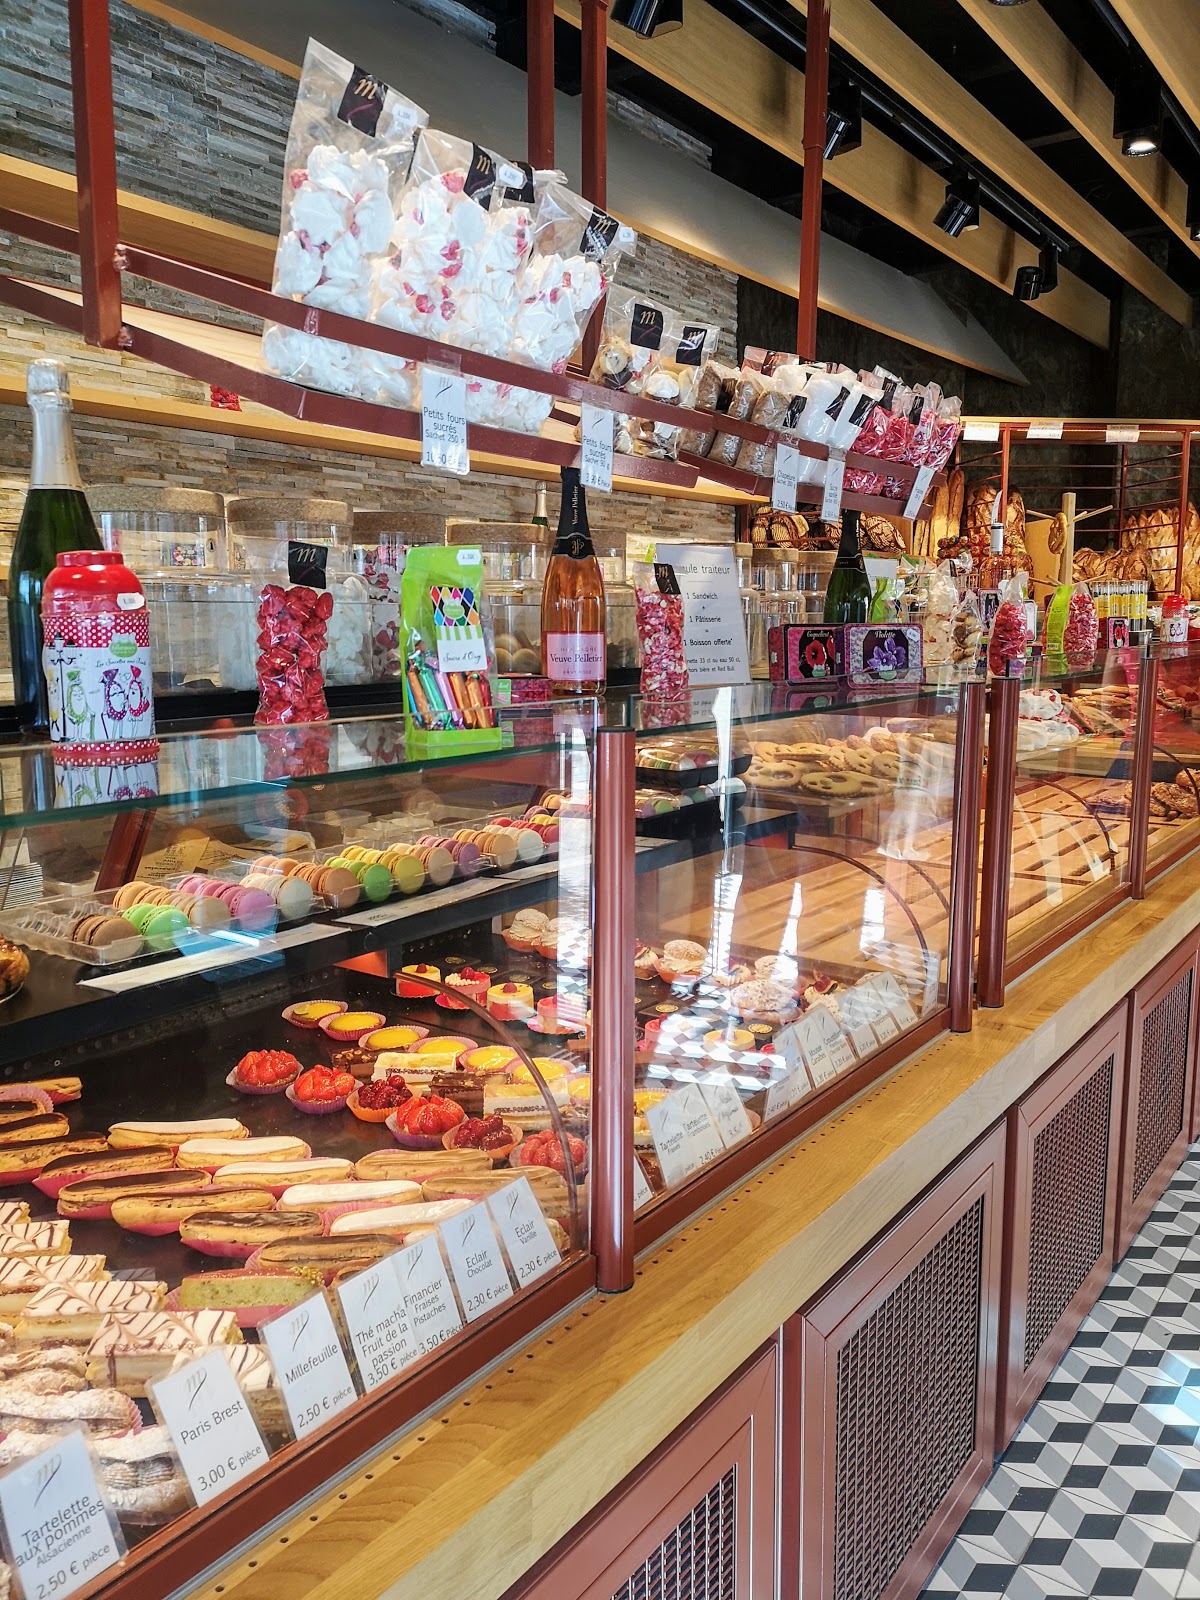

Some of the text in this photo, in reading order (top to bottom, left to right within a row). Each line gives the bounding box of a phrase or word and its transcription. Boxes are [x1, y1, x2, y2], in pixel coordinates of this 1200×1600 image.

[423, 406, 465, 425] Petits fours
[425, 429, 445, 441] Sachet
[447, 434, 458, 443] 250
[433, 421, 457, 434] sucrés
[583, 434, 612, 453] Petits fours
[701, 565, 731, 575] traiteur
[686, 592, 719, 600] 1 Sandwich
[689, 615, 721, 623] 1 Pâtisserie
[683, 639, 687, 647] 1
[550, 653, 603, 663] Veuve Pelletier
[683, 1113, 709, 1132] Tartelette
[659, 1131, 684, 1152] Tartelette
[698, 1150, 712, 1165] 2,40
[711, 1148, 716, 1158] €
[684, 1162, 695, 1174] pièce
[637, 1186, 649, 1199] pièce
[514, 1220, 535, 1239] Eclair
[520, 1230, 538, 1246] Vanille
[465, 1249, 488, 1270] Eclair
[467, 1259, 493, 1279] Chocolat
[518, 1249, 558, 1279] 2,30 € pièce
[403, 1279, 443, 1309] Financier
[414, 1293, 440, 1314] Fraises
[466, 1282, 509, 1313] 2,30 € pièce
[355, 1307, 407, 1345] Thé macha
[413, 1303, 447, 1328] Pistaches
[361, 1323, 408, 1358] Fruit de la
[419, 1333, 440, 1356] 3,50
[439, 1329, 446, 1343] €
[285, 1344, 339, 1385] Millefeuille
[371, 1338, 407, 1370] passion
[367, 1348, 418, 1387] 3,50 € pièce
[297, 1385, 353, 1428] 2,50 € pièce
[180, 1399, 244, 1445] Paris Brest
[197, 1445, 263, 1492] 3,00 € pièce
[22, 1495, 91, 1547] Tartelette
[15, 1499, 105, 1568] aux pommes
[36, 1524, 93, 1569] Alsacienne
[36, 1543, 111, 1600] 2,50 € pièce
